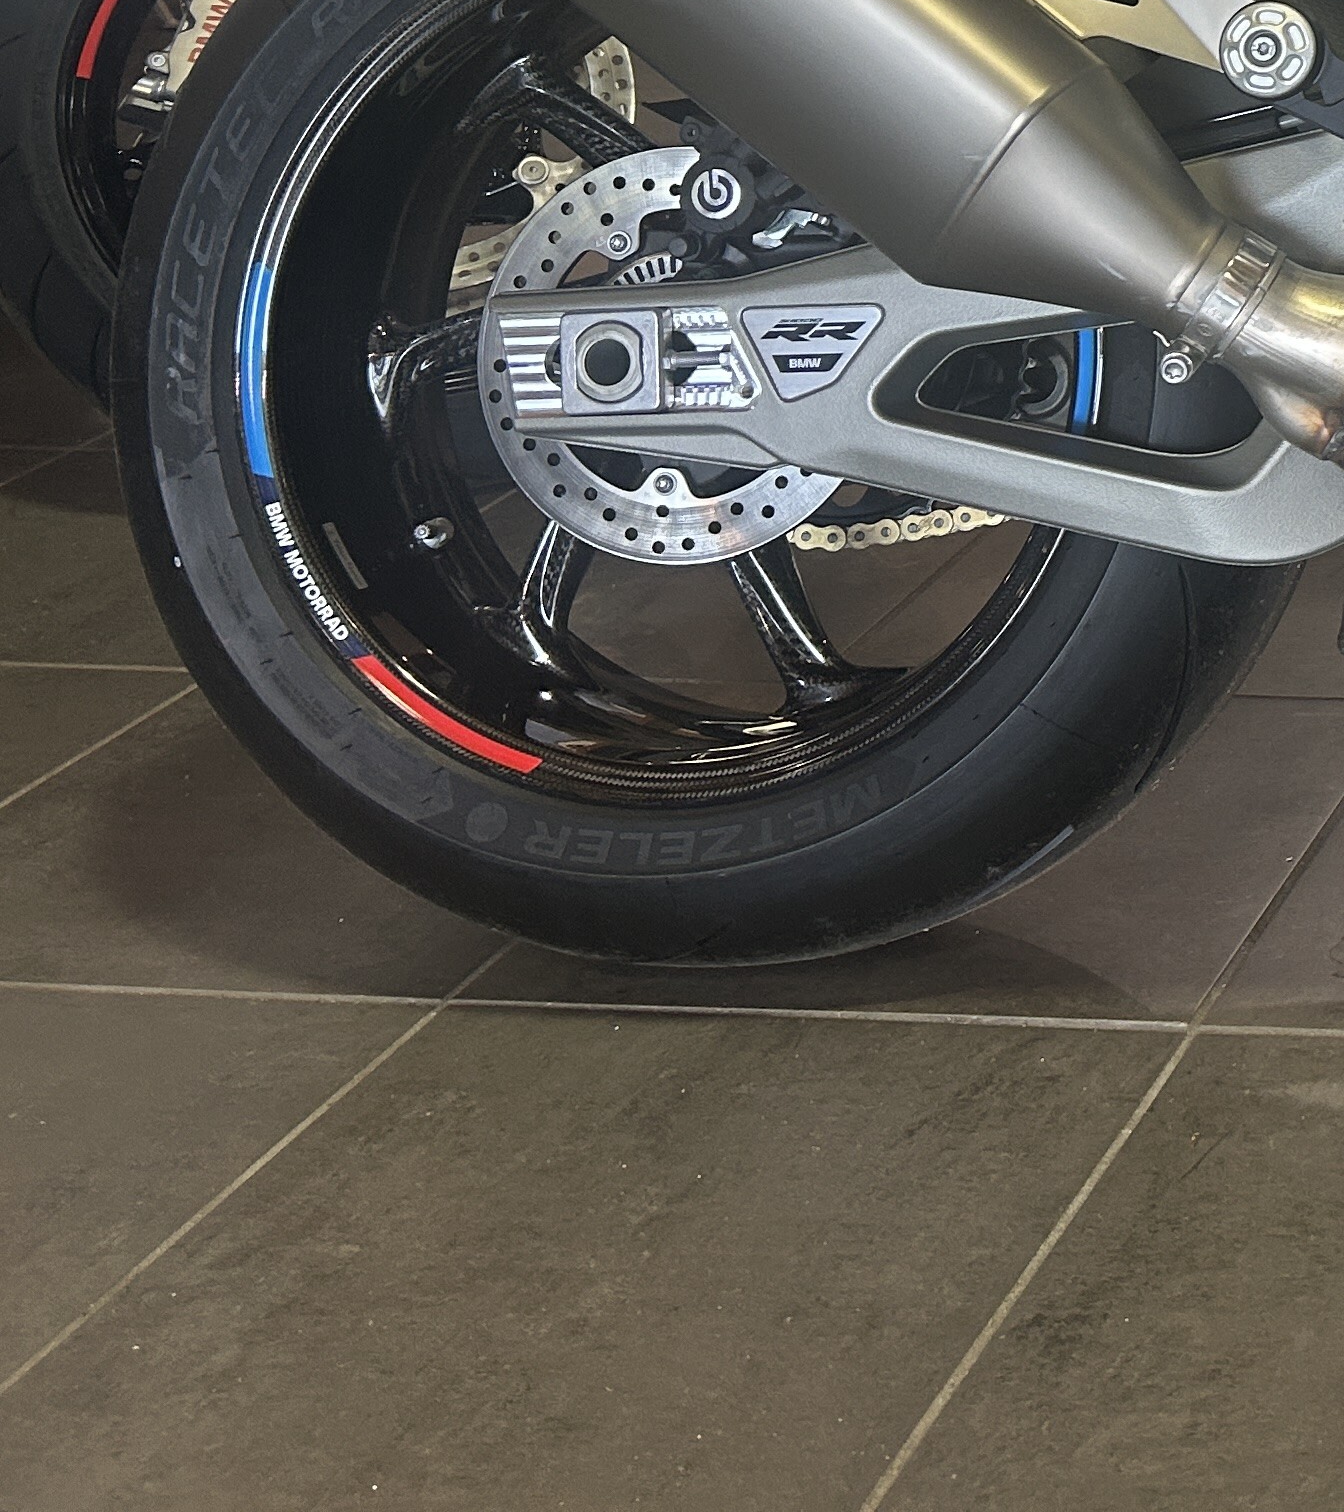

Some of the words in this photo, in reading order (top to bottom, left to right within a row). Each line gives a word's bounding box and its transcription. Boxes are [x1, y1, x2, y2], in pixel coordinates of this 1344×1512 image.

[760, 321, 866, 342] RR
[788, 357, 822, 368] BMW
[265, 501, 295, 547] BMW
[283, 548, 349, 642] MOTORRAD
[523, 774, 882, 865] METZELER
